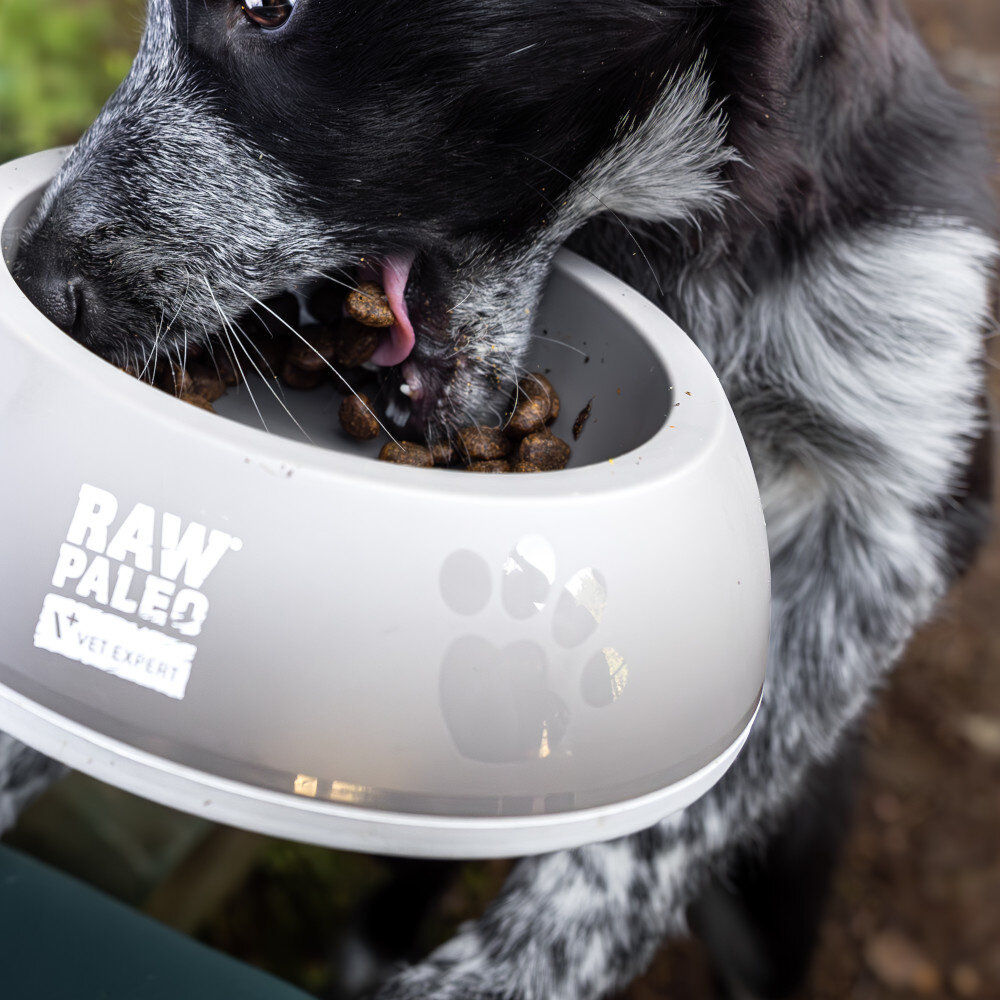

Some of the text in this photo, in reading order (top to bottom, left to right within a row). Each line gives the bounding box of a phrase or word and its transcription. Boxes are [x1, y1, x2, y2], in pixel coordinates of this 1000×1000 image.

[66, 483, 234, 589] RAW
[52, 542, 209, 637] PALEO
[77, 630, 179, 682] VET EXPERT
